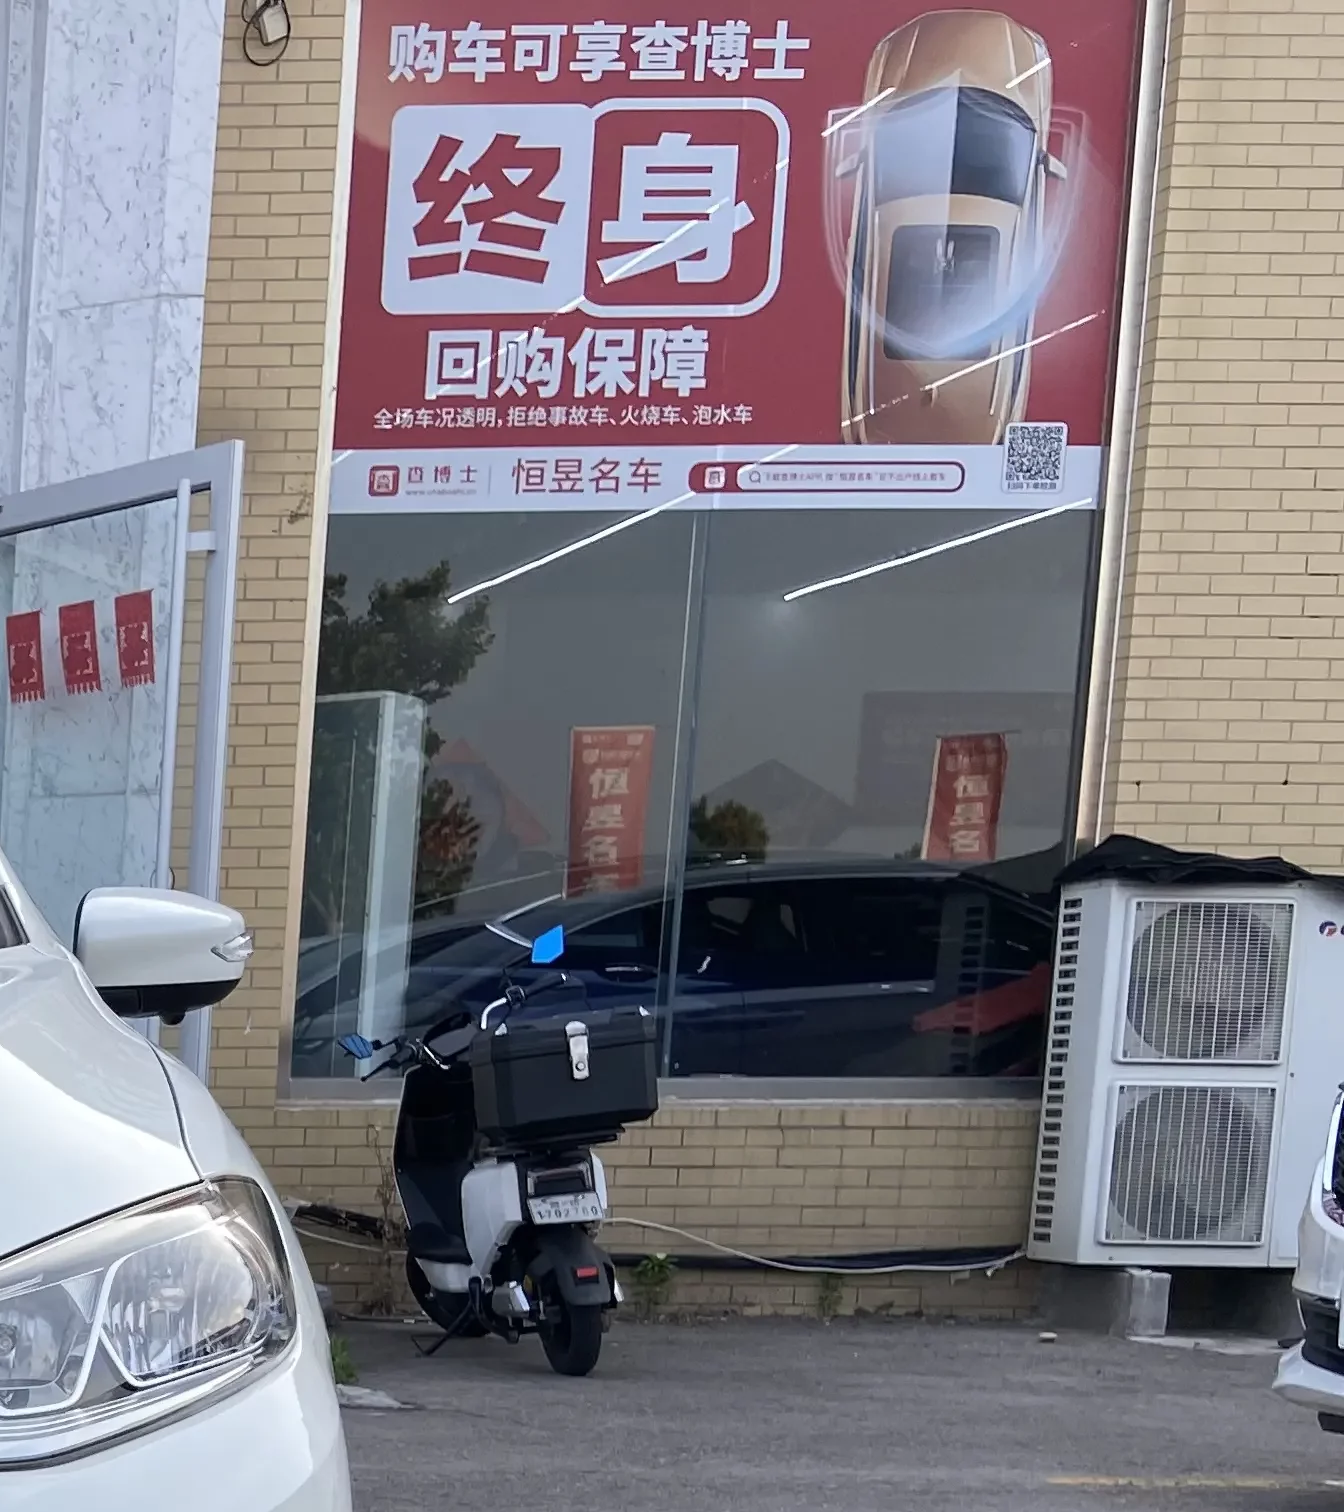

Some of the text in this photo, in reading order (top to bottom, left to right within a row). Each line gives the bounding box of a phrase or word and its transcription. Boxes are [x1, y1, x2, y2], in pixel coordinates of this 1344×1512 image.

[387, 19, 810, 83] 购车可享查博士
[407, 131, 755, 284] 终身
[425, 325, 709, 399] 回购保障
[512, 457, 662, 494] 恒昱名车
